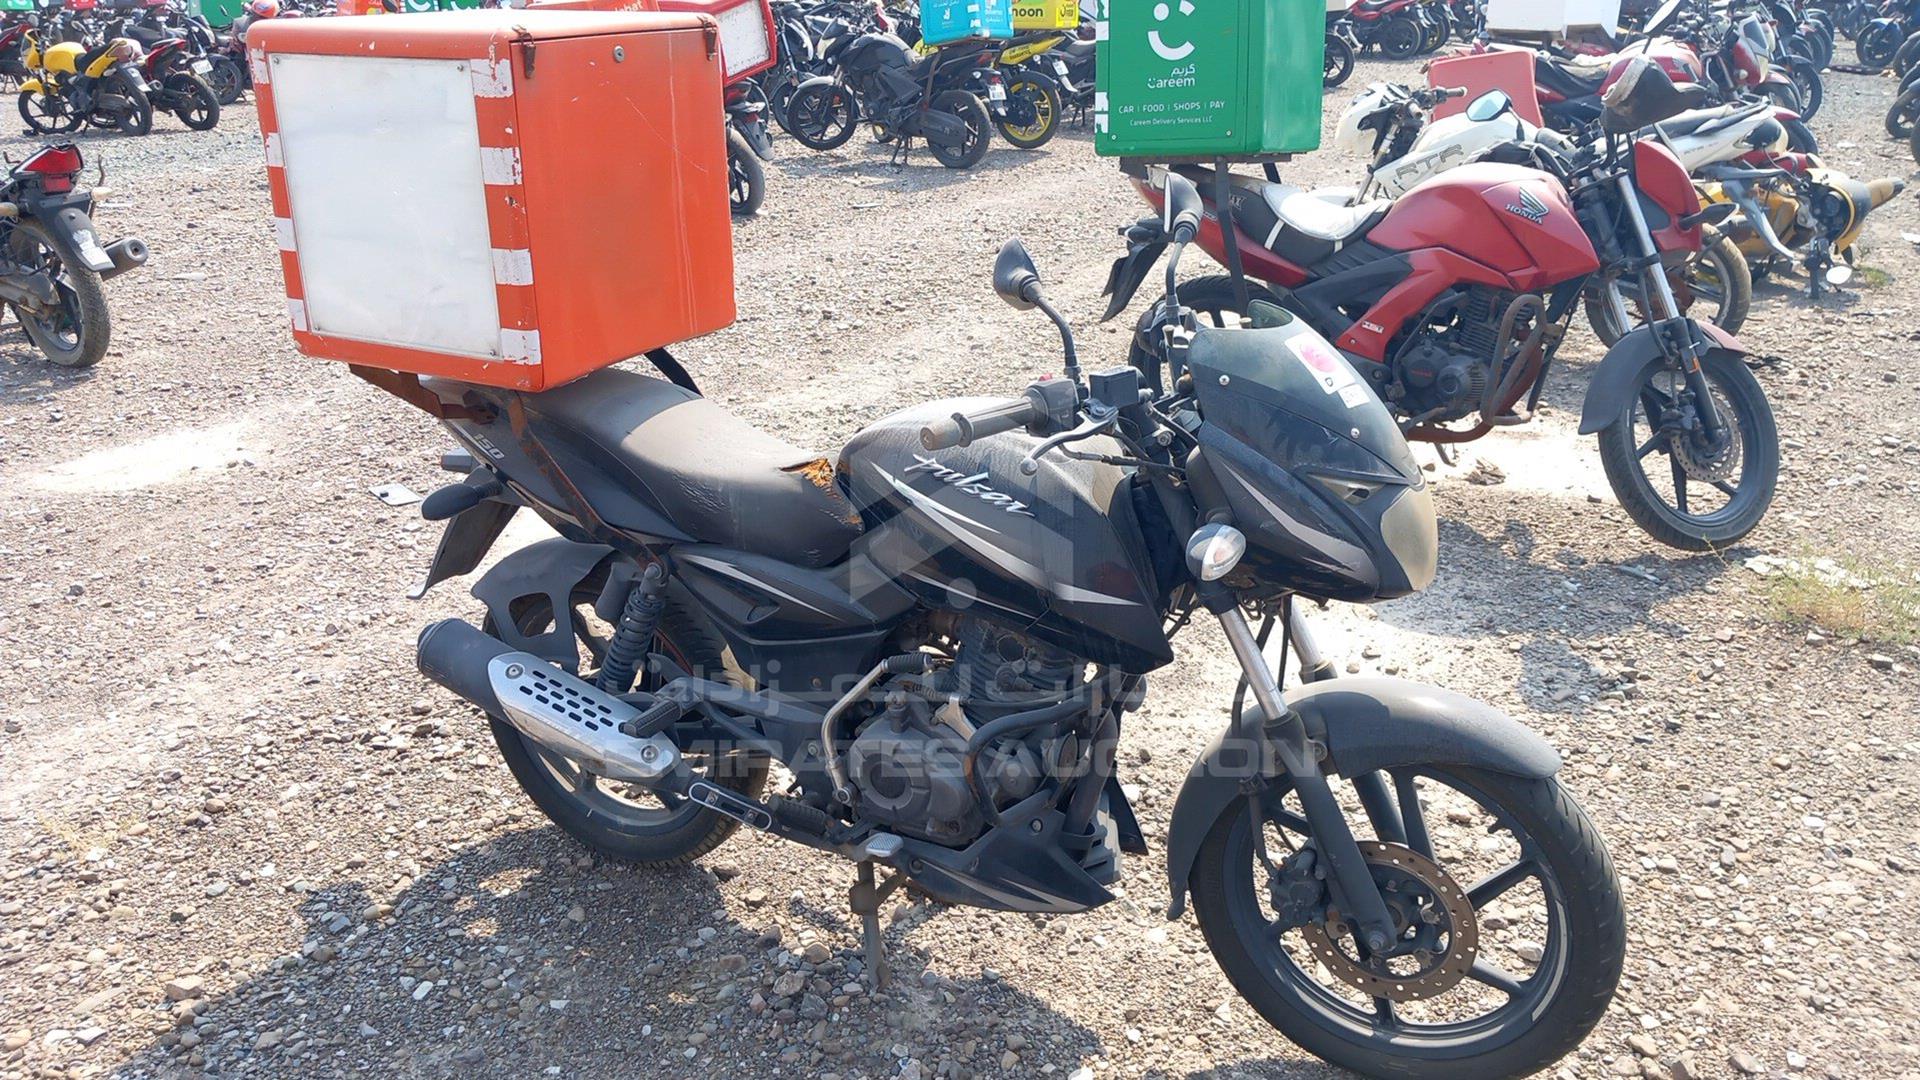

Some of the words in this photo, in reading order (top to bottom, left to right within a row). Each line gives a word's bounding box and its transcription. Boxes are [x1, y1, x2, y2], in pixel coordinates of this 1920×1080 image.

[1012, 8, 1043, 17] noon
[1170, 63, 1196, 77] كريم
[1147, 77, 1196, 89] Careem
[1118, 105, 1134, 114] CAR
[1142, 103, 1165, 113] FOOD
[1173, 102, 1201, 111] SHOPS
[1209, 100, 1226, 109] PAY
[1129, 119, 1152, 127] Careem
[1152, 118, 1176, 126] Delivery
[1177, 116, 1201, 124] Services
[1202, 115, 1213, 123] LLC
[1395, 143, 1464, 180] RTR
[1504, 203, 1544, 225] HONDA
[473, 433, 505, 459] 150
[904, 453, 1036, 517] Pulsar
